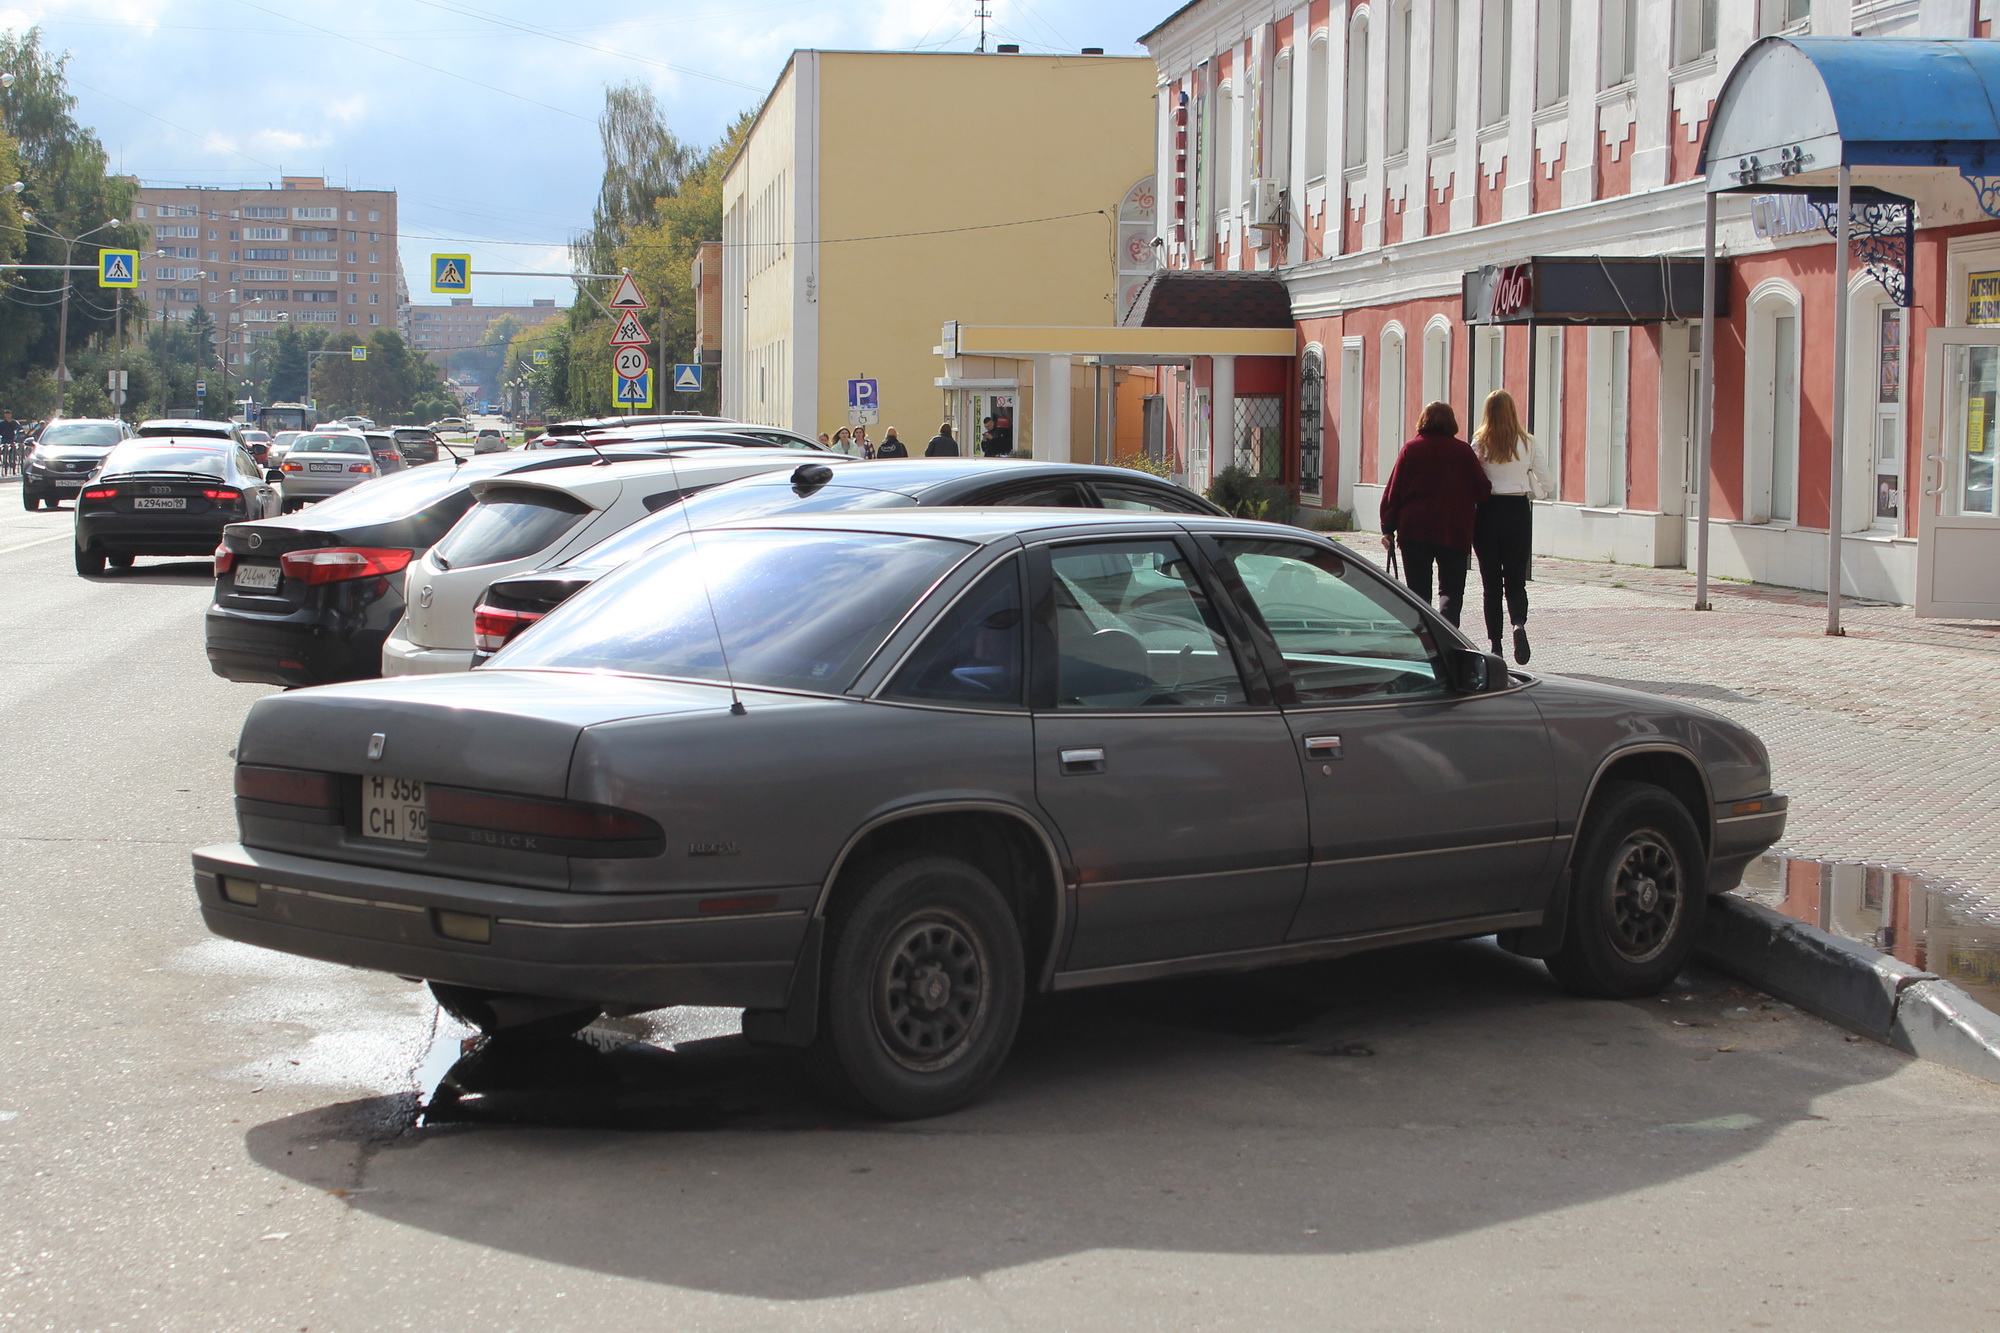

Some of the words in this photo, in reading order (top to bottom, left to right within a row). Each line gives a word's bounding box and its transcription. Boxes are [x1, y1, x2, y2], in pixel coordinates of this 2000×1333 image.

[621, 355, 641, 369] 20
[855, 382, 872, 407] P
[137, 499, 173, 508] А294МО
[371, 776, 384, 799] Н
[370, 807, 395, 835] СН
[409, 810, 426, 831] 90
[471, 831, 537, 849] BUICK
